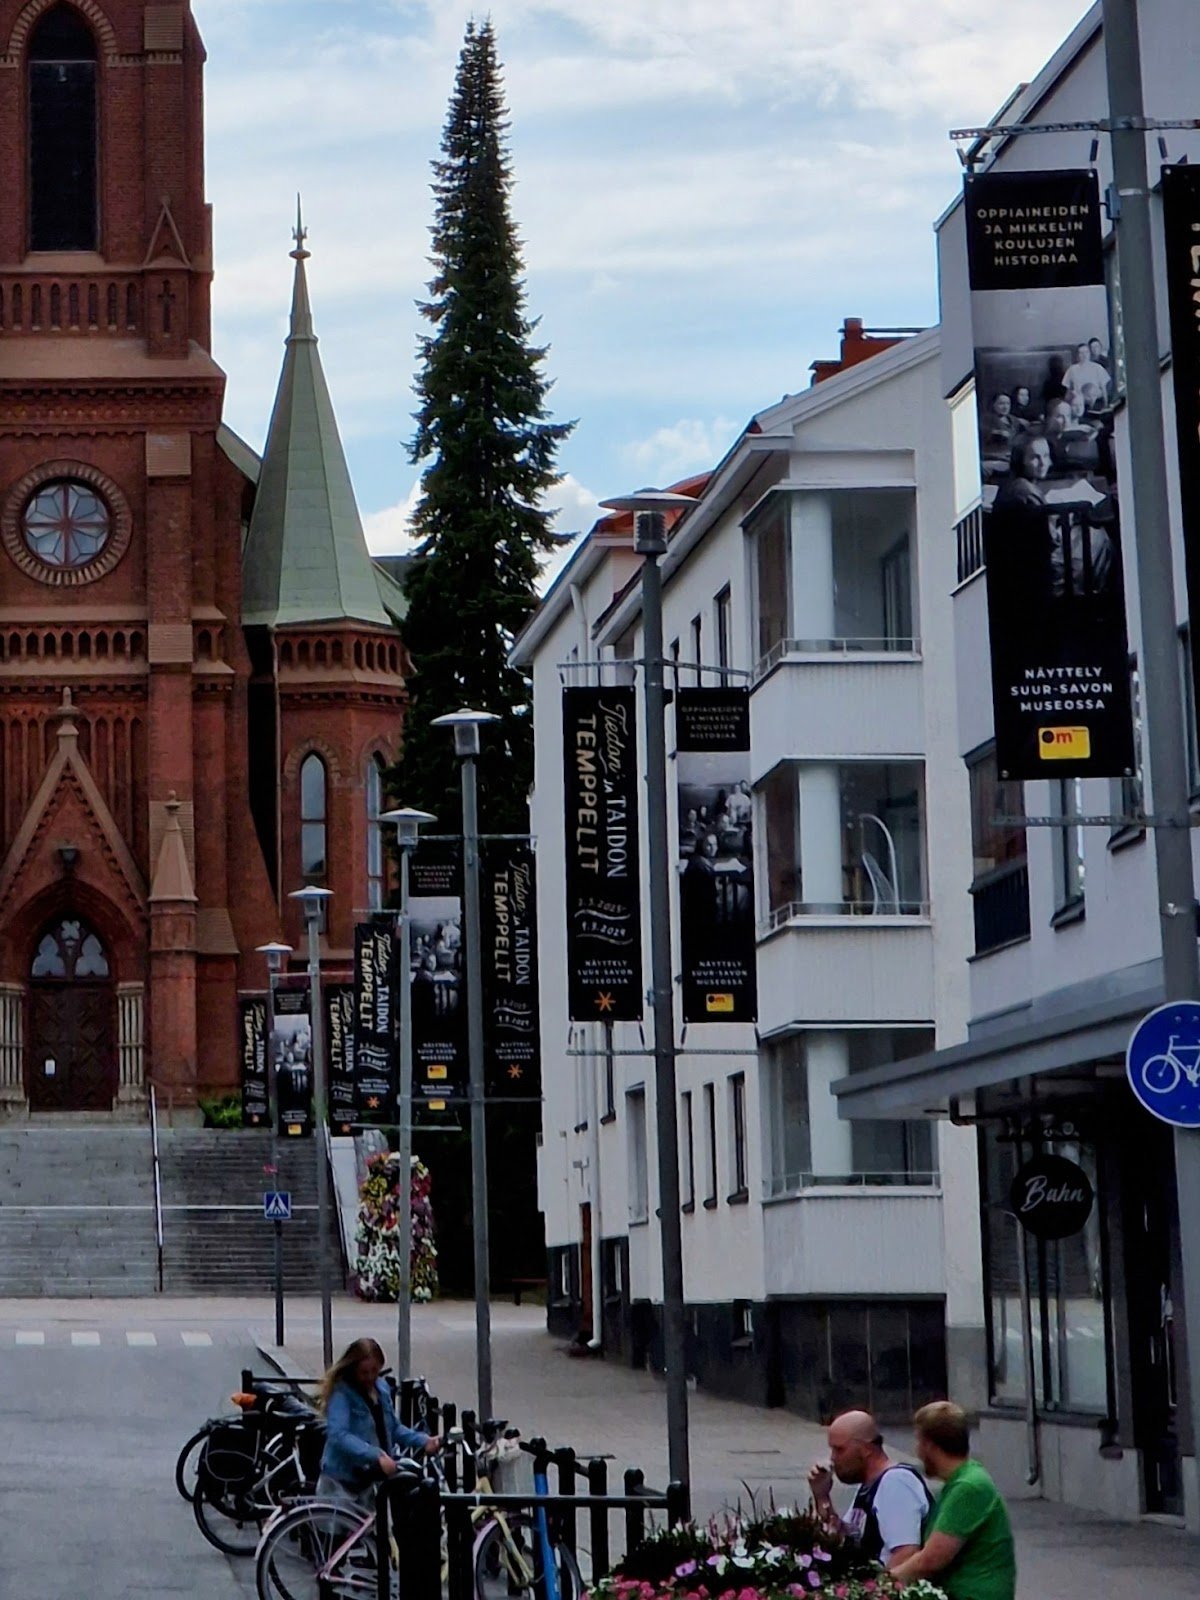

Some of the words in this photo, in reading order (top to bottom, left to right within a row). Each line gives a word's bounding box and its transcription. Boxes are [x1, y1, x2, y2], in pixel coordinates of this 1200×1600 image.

[977, 204, 1090, 219] OPPIAINEIDEN
[984, 224, 1003, 235] JA
[1009, 221, 1084, 234] MIKKELIN
[994, 237, 1075, 250] KOULUJEN
[993, 253, 1079, 266] HISTORIAA
[1024, 666, 1102, 679] NÄYTTELY
[1010, 682, 1113, 697] SUUR-SAVON
[1020, 699, 1106, 712] MUSEOSSA
[576, 713, 599, 875] TEMPPELIT
[606, 795, 628, 878] TAIDON
[493, 871, 511, 983] TEMPPELIT
[515, 927, 530, 985] TAIDON
[359, 938, 374, 1031] TEMPPELIT
[376, 985, 390, 1033] TAIDON
[329, 996, 343, 1071] TEMPPELIT
